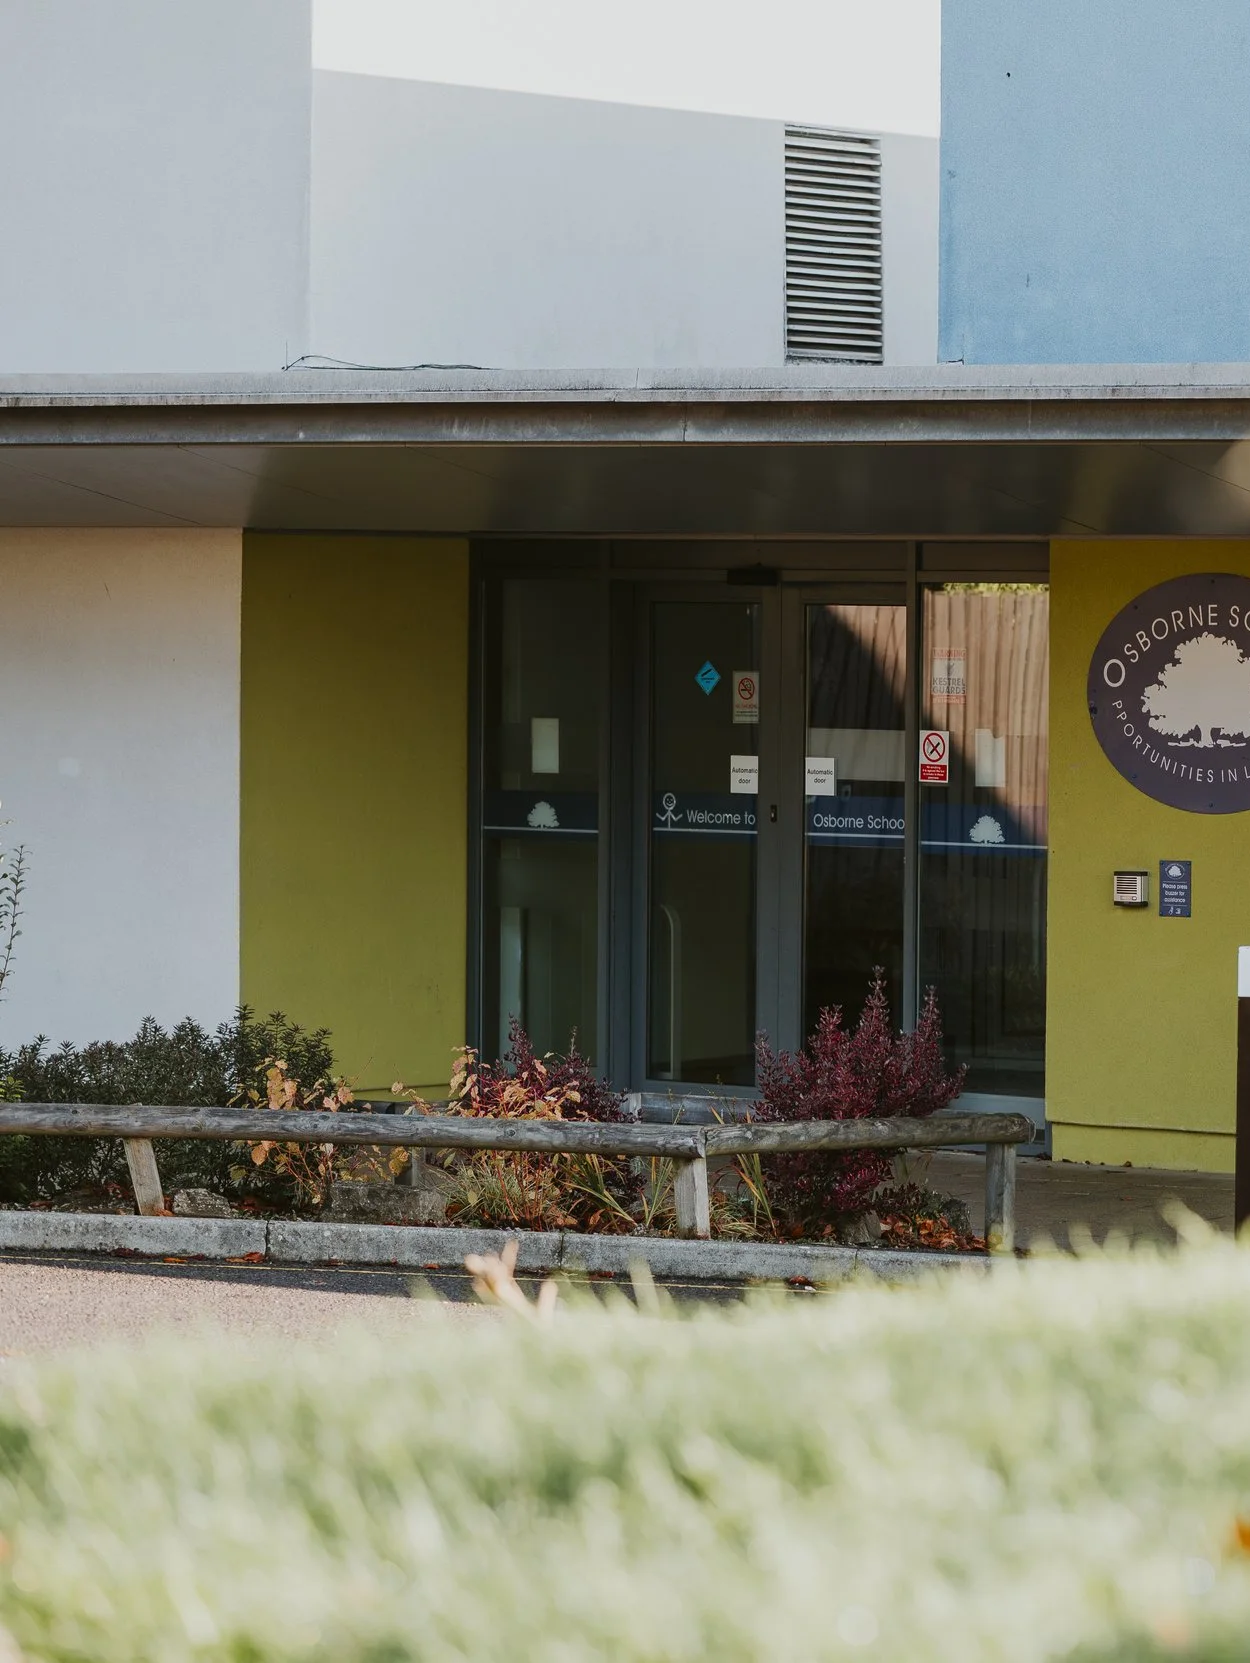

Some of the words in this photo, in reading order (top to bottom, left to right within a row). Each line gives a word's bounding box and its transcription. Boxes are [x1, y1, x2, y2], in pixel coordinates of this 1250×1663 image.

[1103, 604, 1218, 688] OSBORNE
[932, 677, 966, 687] KESTREL
[932, 686, 966, 694] GUARDS
[731, 766, 758, 774] Automatic
[1221, 768, 1238, 783] IN
[686, 809, 742, 825] Welcome
[744, 811, 756, 825] to
[813, 813, 864, 829] Osborne
[867, 814, 906, 830] Schoo
